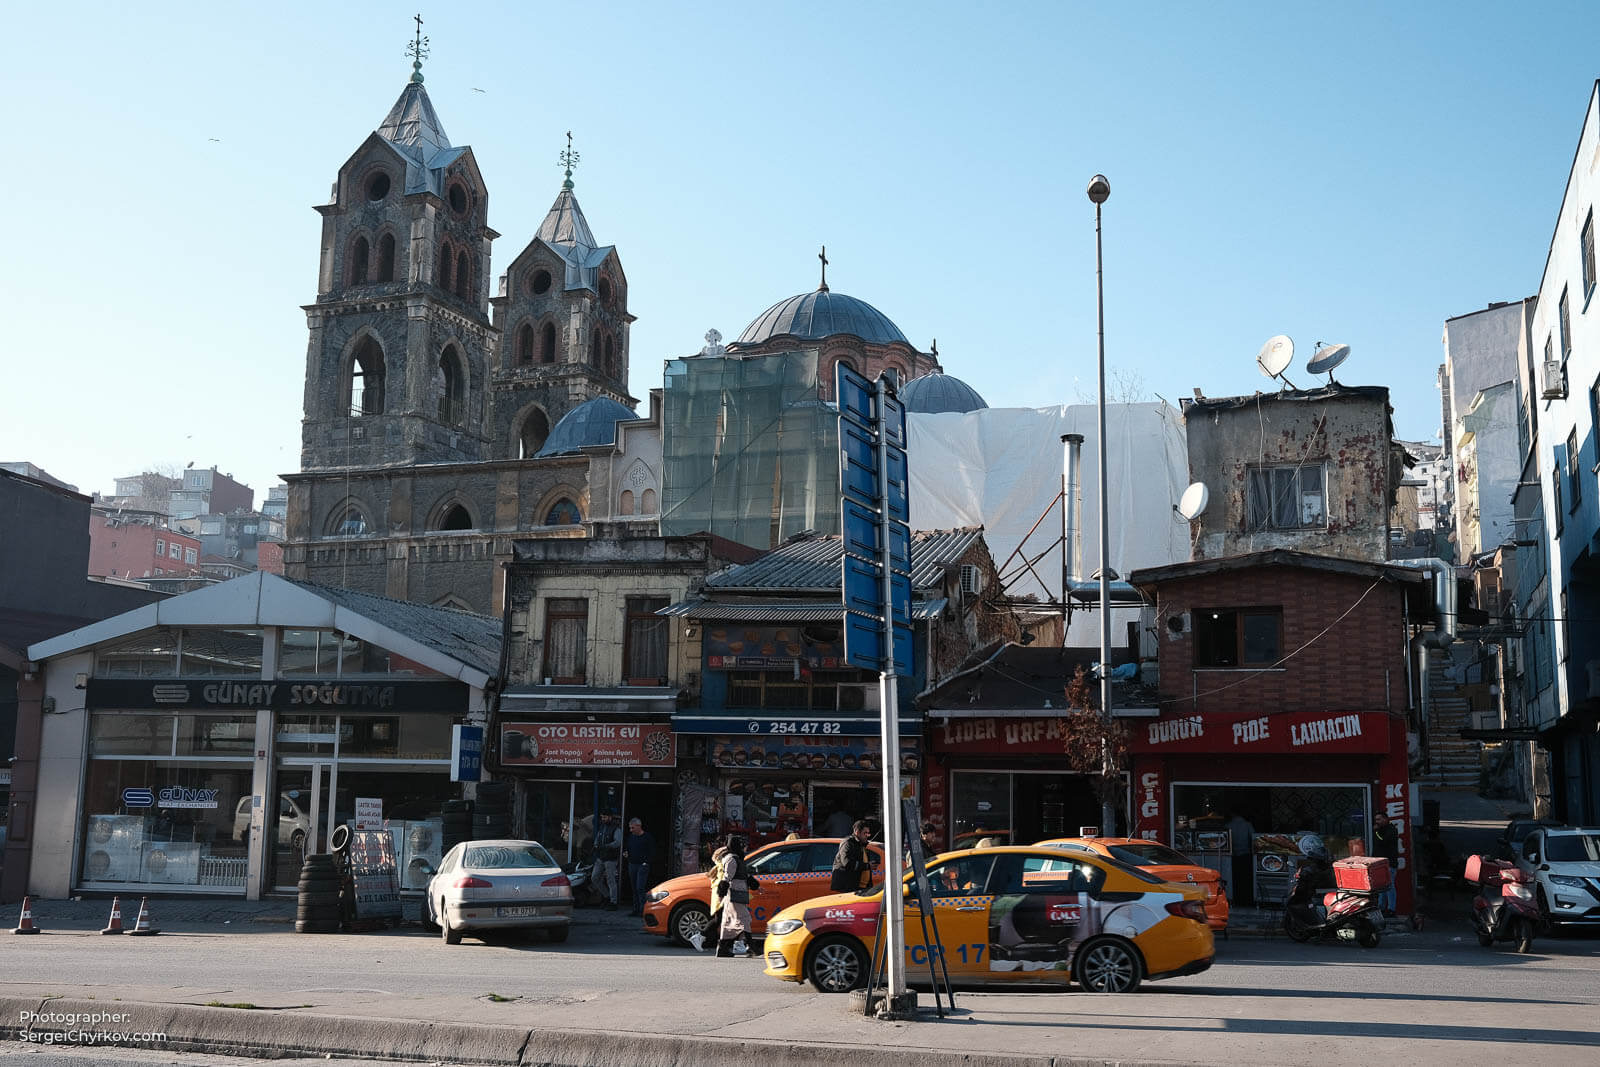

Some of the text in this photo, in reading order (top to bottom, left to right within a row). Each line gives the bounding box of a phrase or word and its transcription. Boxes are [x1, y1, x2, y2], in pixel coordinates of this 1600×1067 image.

[202, 680, 396, 707] GÜNAY SOĞUTMA
[538, 723, 641, 739] OTO LASTİK EVİ
[769, 722, 842, 734] 254 47 82
[1290, 713, 1362, 746] LAHMACUN
[160, 785, 218, 801] GÜNAY
[957, 943, 986, 964] 17
